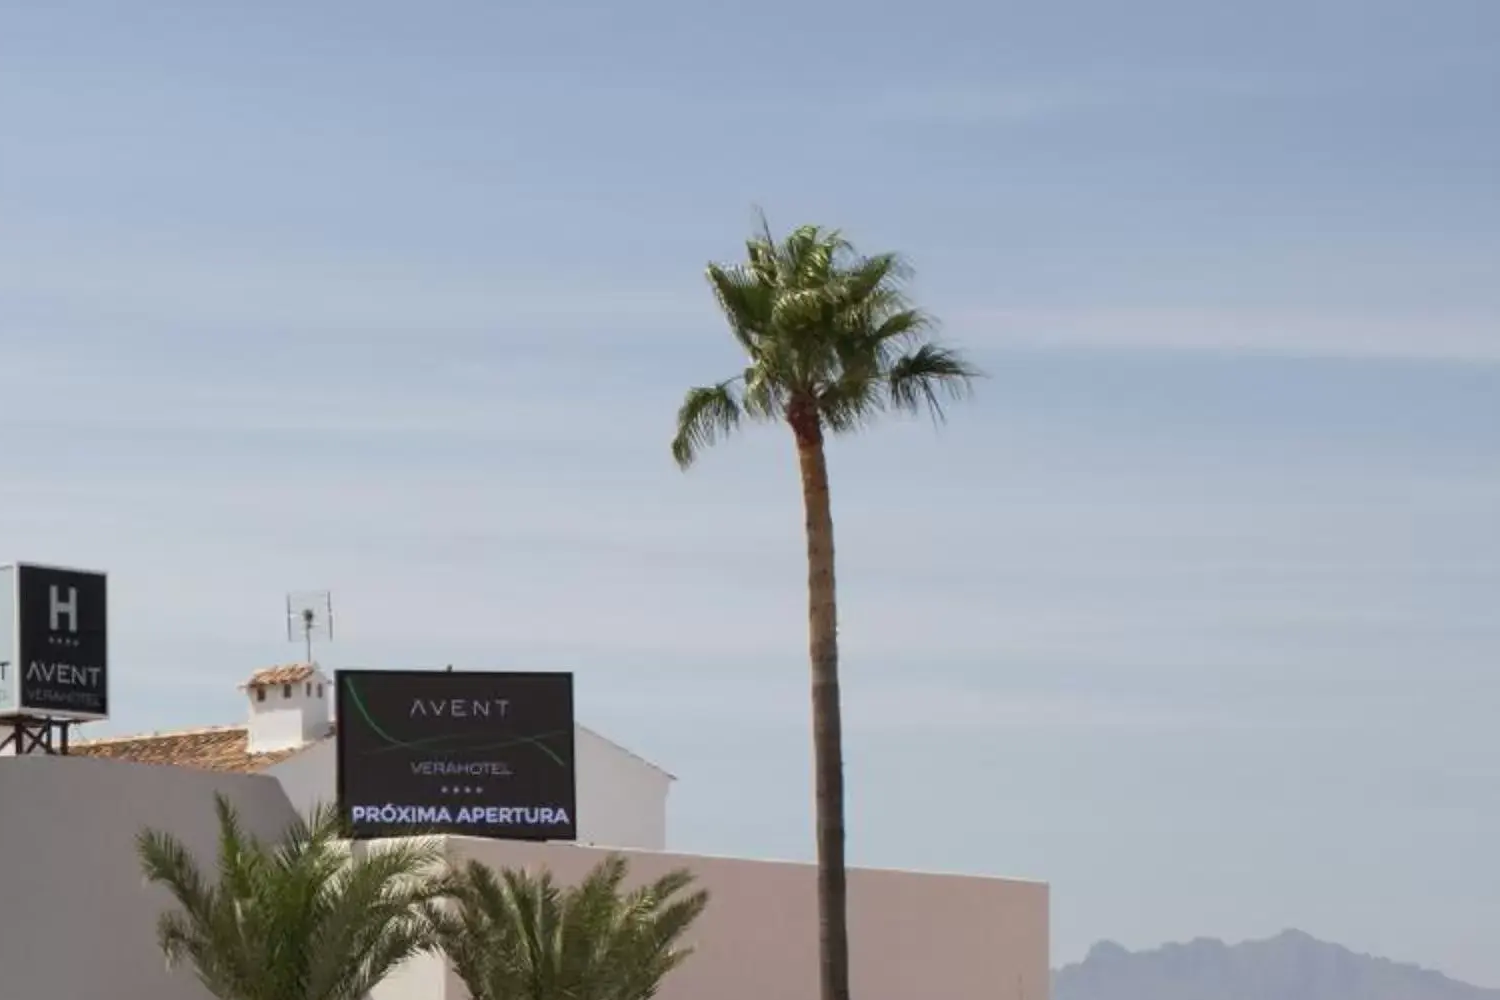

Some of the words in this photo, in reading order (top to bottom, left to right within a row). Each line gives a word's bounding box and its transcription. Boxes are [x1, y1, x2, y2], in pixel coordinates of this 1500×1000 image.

[49, 585, 78, 633] H
[25, 660, 100, 687] AVENT
[410, 700, 509, 717] AVENT
[410, 761, 513, 776] VERAHOTEL
[352, 804, 451, 824] PRÓXIMA
[456, 807, 569, 825] APERTURA
